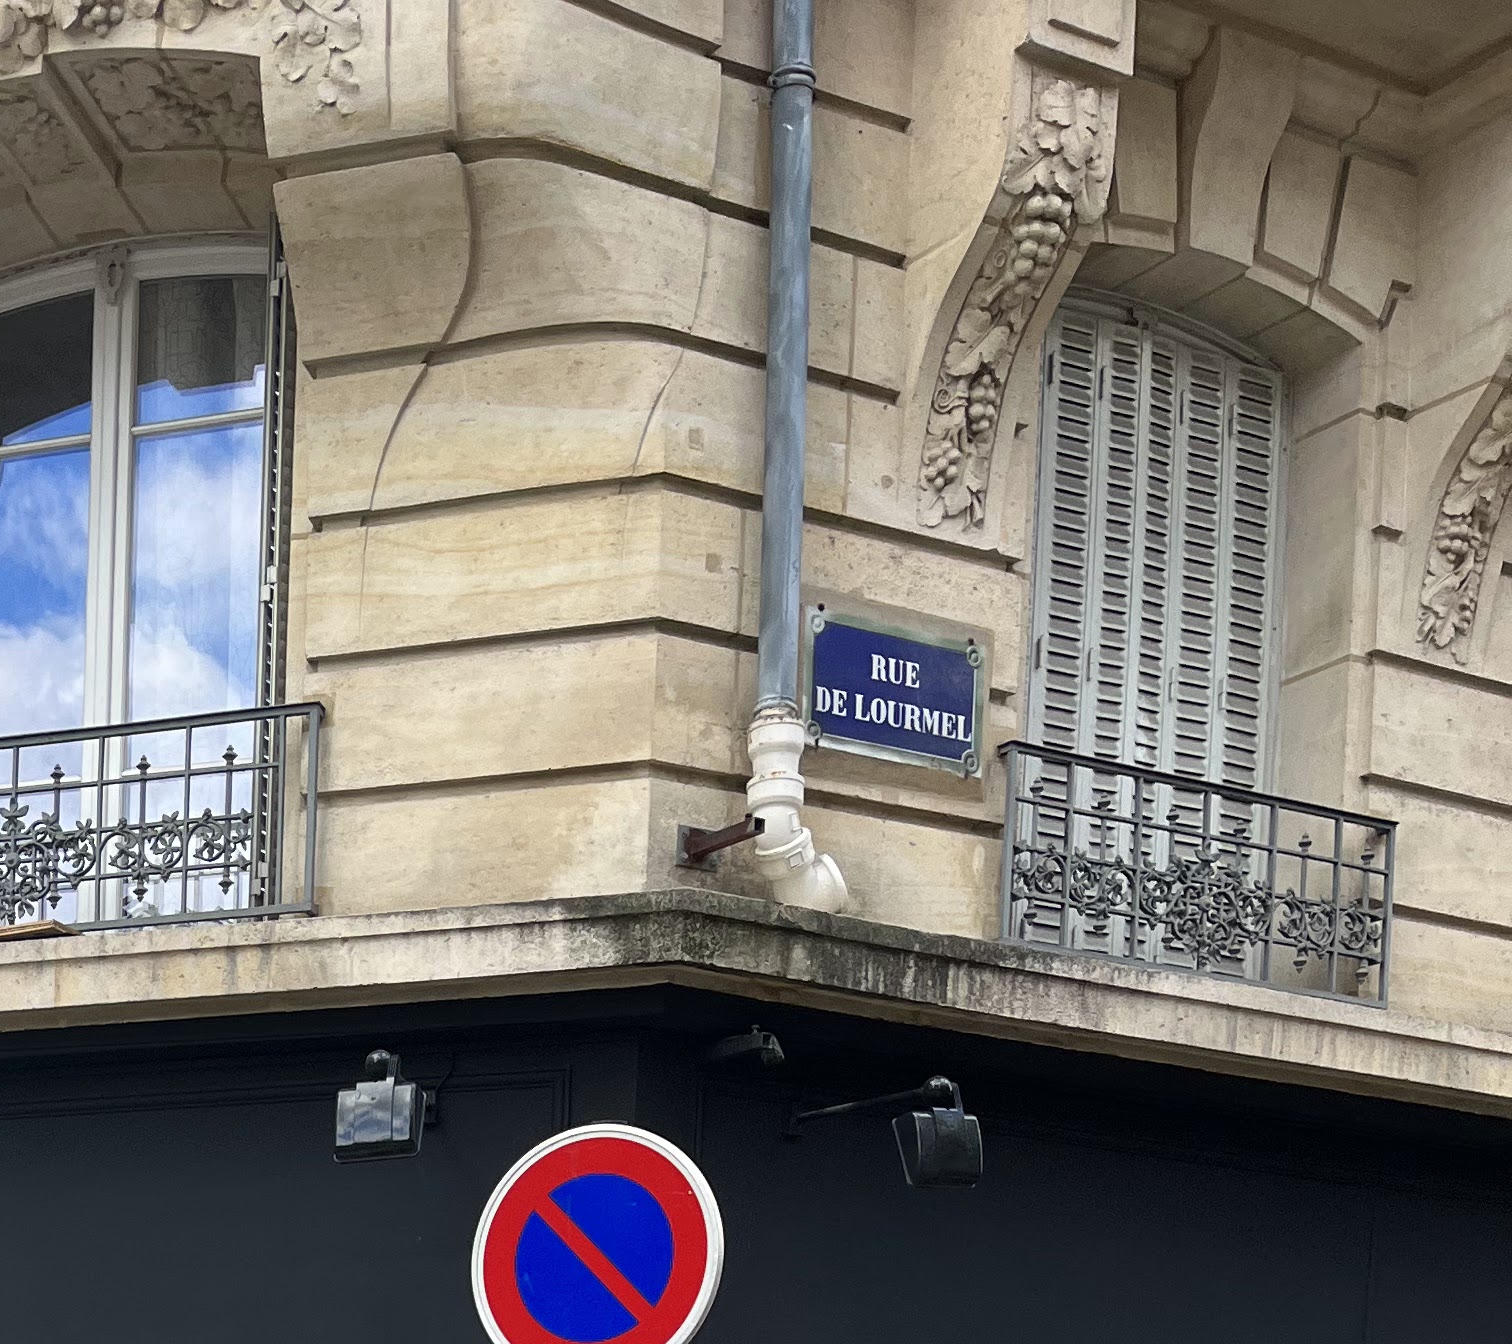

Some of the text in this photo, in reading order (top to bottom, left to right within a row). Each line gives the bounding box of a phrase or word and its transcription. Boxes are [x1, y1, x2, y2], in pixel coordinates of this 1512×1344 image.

[870, 653, 920, 689] RUE
[815, 685, 972, 742] DE LOURMEL
